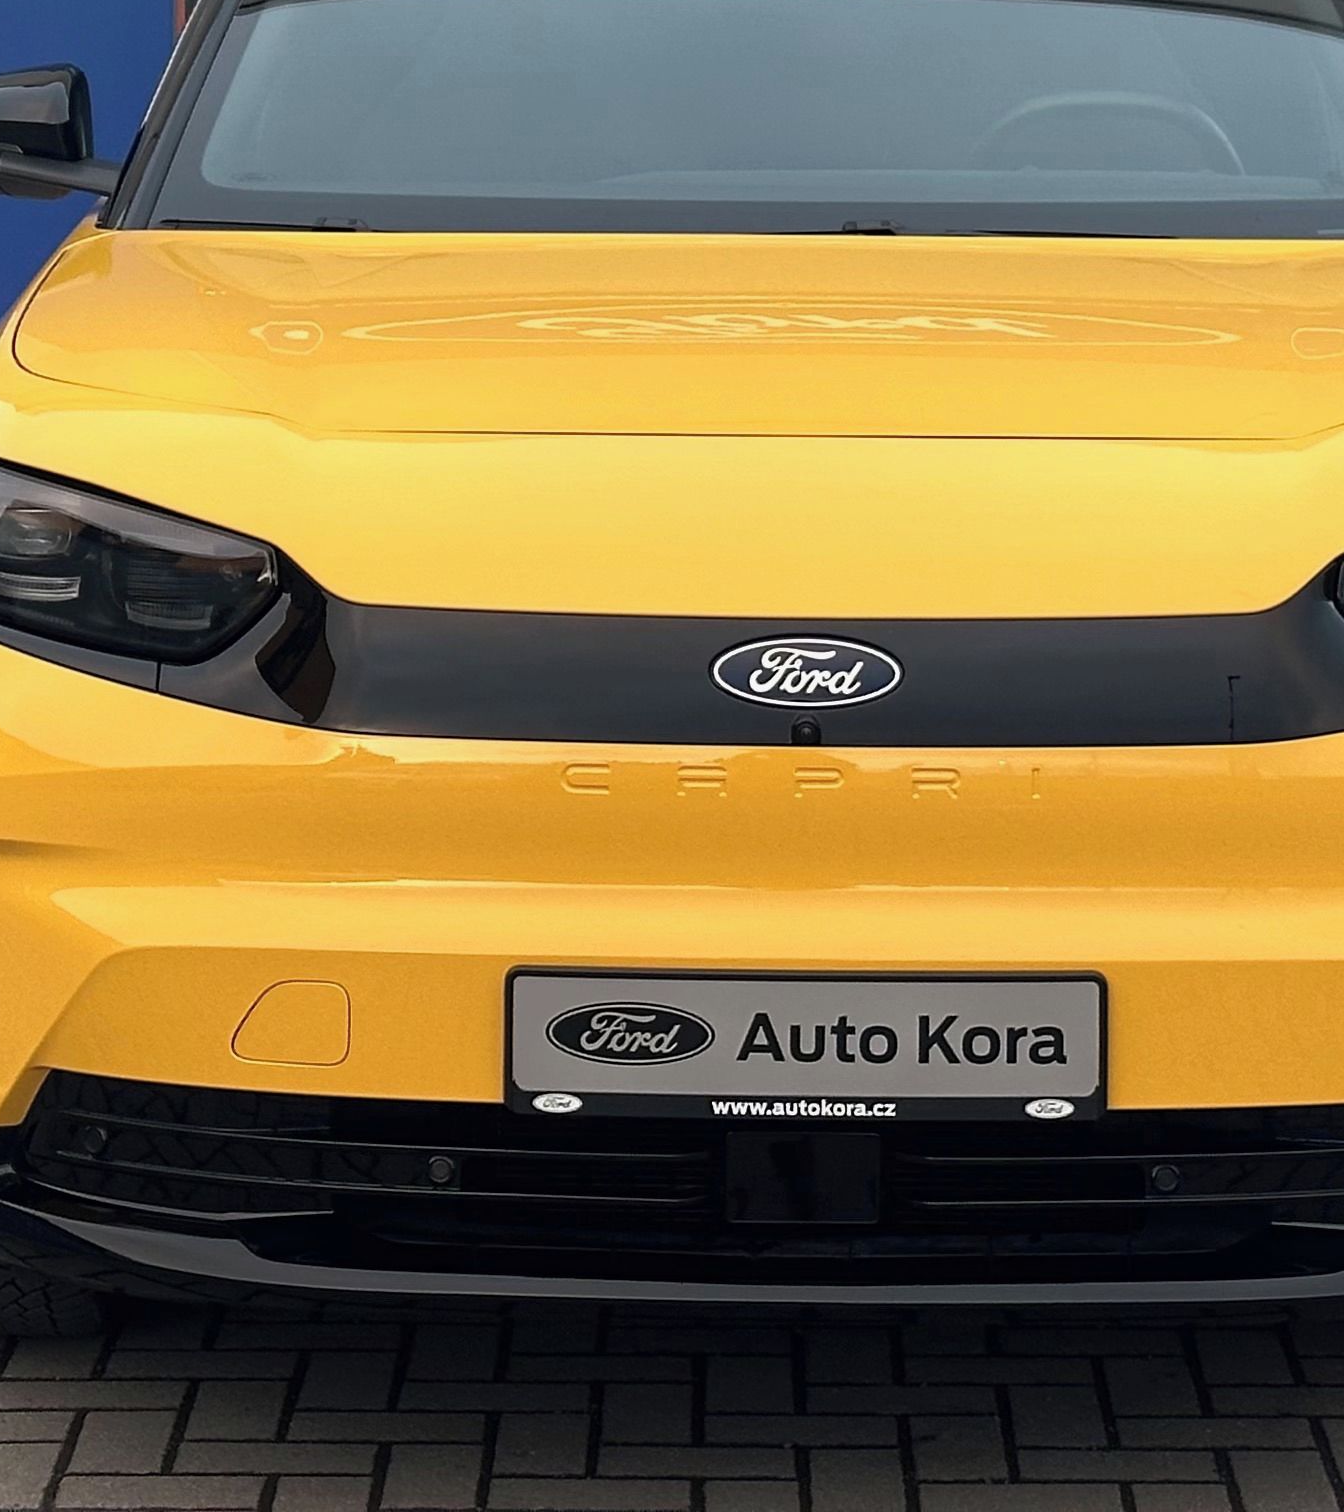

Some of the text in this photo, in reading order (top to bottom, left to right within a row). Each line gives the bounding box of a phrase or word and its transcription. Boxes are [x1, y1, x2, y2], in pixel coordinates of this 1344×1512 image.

[749, 647, 864, 695] Ford
[559, 761, 1042, 800] CAPRI
[580, 1011, 1068, 1065] Ford Auto Kora
[711, 1098, 897, 1117] www.autokora.cz
